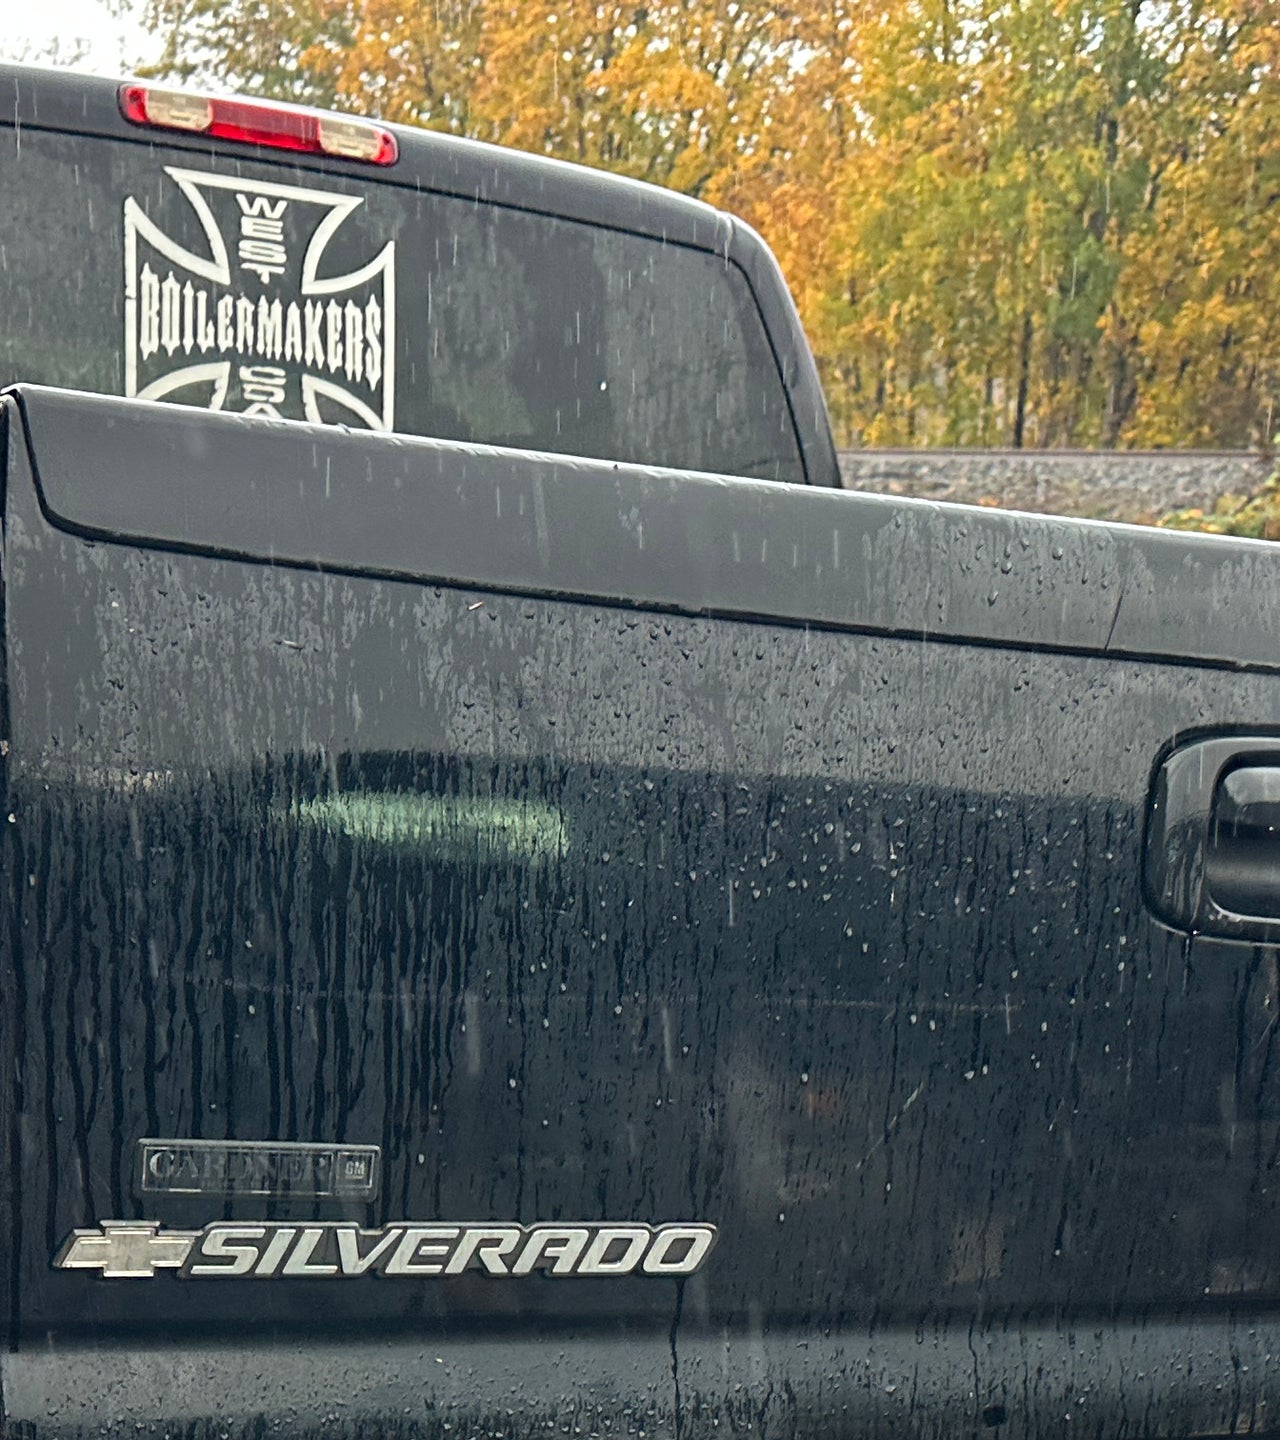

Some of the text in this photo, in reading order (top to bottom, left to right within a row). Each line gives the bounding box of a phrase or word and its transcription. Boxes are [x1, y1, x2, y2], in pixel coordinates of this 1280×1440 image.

[235, 193, 288, 285] WEST
[139, 262, 382, 391] BOILERMAKERS
[344, 1161, 366, 1180] GM
[190, 1226, 715, 1275] SILVERADO
